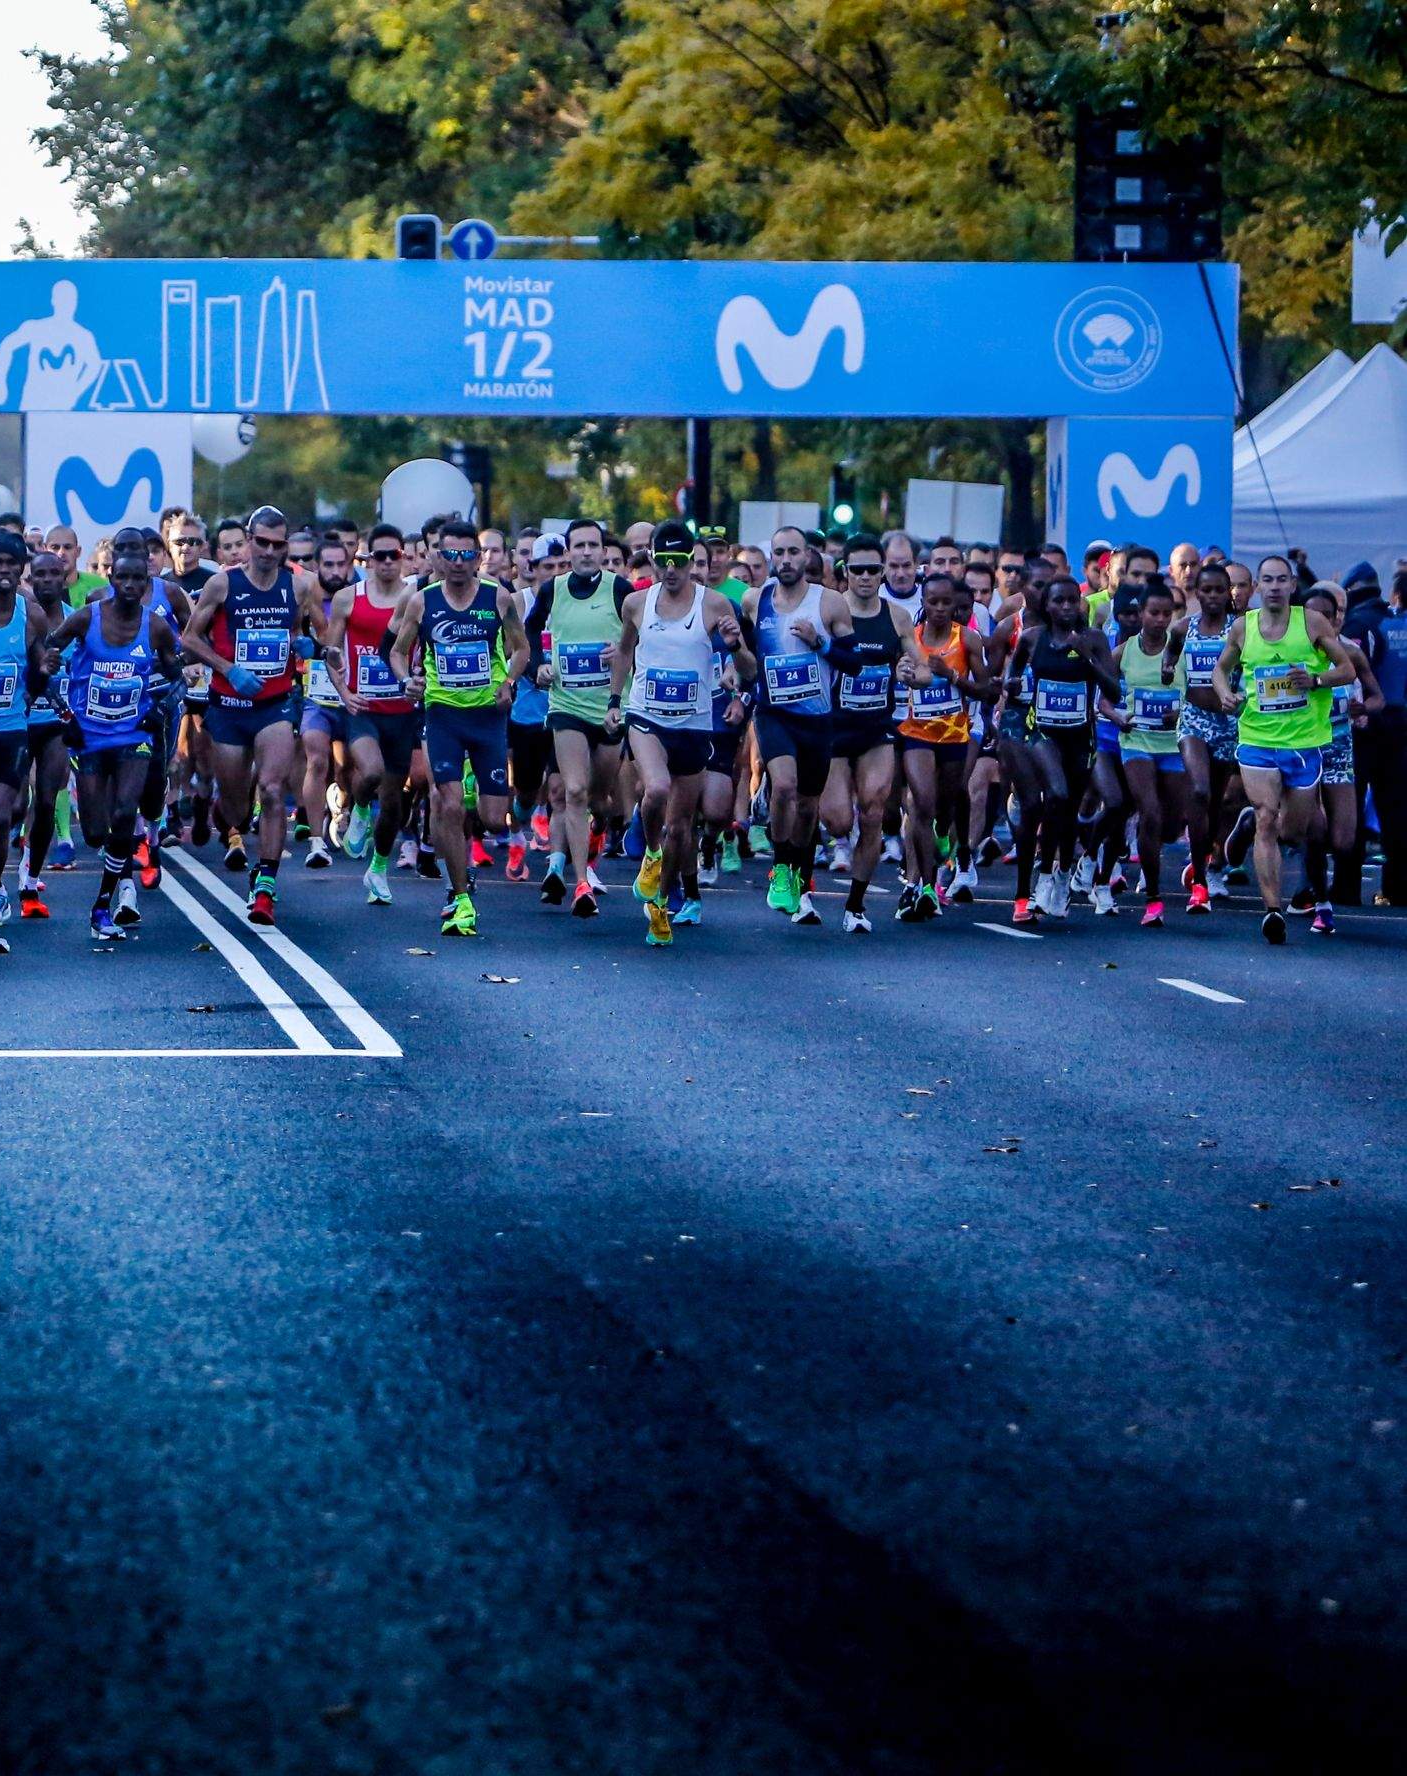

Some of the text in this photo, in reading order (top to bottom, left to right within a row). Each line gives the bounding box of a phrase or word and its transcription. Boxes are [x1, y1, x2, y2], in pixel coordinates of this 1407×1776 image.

[465, 276, 553, 293] Movistar
[465, 297, 553, 328] MAD
[465, 331, 553, 378] 1/2
[465, 380, 553, 397] MARATÓN
[257, 646, 269, 656] 53
[456, 659, 468, 668] 50
[578, 658, 590, 668] 54
[786, 671, 799, 681] 24
[665, 686, 678, 696] 52
[1051, 696, 1073, 707] F102
